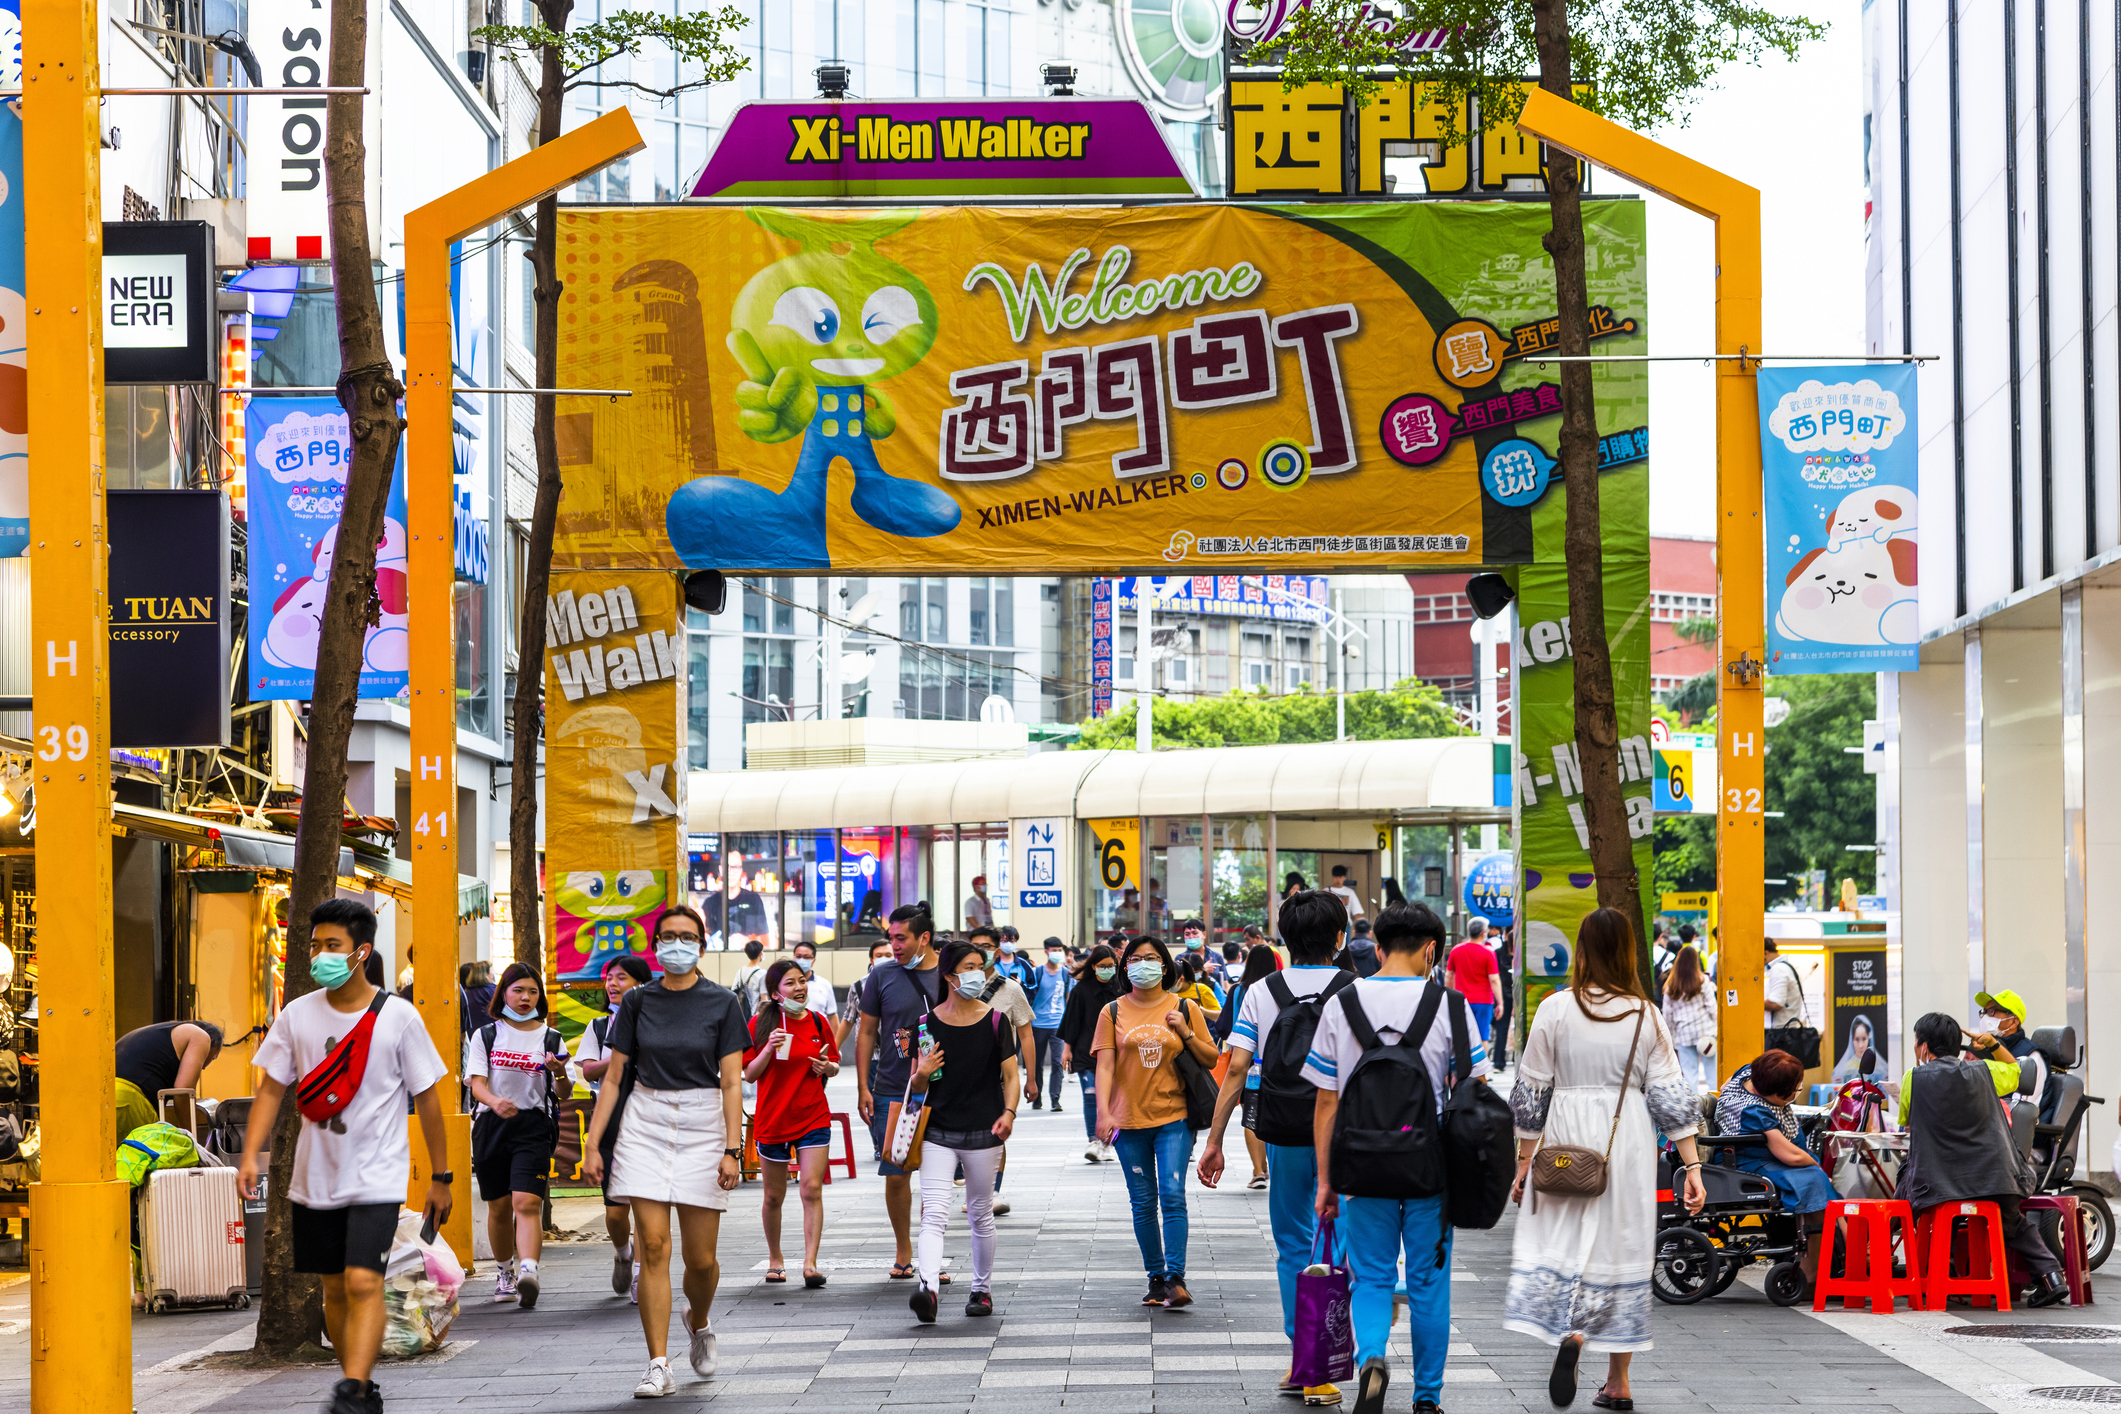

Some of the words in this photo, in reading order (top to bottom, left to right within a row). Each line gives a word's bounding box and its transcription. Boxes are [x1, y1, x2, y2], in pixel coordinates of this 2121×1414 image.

[281, 27, 327, 192] salon
[787, 115, 935, 162] Xi-Men
[938, 117, 1091, 160] Walker
[110, 276, 173, 300] NEW
[648, 290, 681, 301] Grand
[963, 245, 1263, 342] Welcome
[110, 303, 173, 327] ERA
[1514, 308, 1613, 352] 西門化
[1447, 332, 1494, 377] 覽
[938, 302, 1359, 481] 西門町
[1461, 384, 1561, 429] 西門美食
[1788, 408, 1892, 441] 西門町
[1493, 451, 1536, 495] 拼
[294, 512, 314, 520] Happy
[976, 473, 1190, 529] XIMEN-WALKER
[1198, 534, 1470, 552] 社團法人台北市西門徒步區街區發展促進會
[124, 597, 213, 620] TUAN
[546, 585, 639, 649] Men
[1119, 596, 1200, 611] 中小辦公室出租
[46, 640, 77, 676] H
[38, 725, 89, 762] 39
[1733, 732, 1754, 757] H
[420, 755, 442, 780] H
[1670, 765, 1685, 800] 6
[1726, 788, 1761, 813] 32
[414, 811, 447, 838] 41
[1377, 832, 1387, 851] 6
[1102, 838, 1126, 889] 6
[1036, 893, 1058, 905] 20m
[1852, 960, 1873, 971] STOP
[489, 1050, 532, 1061] DANCE
